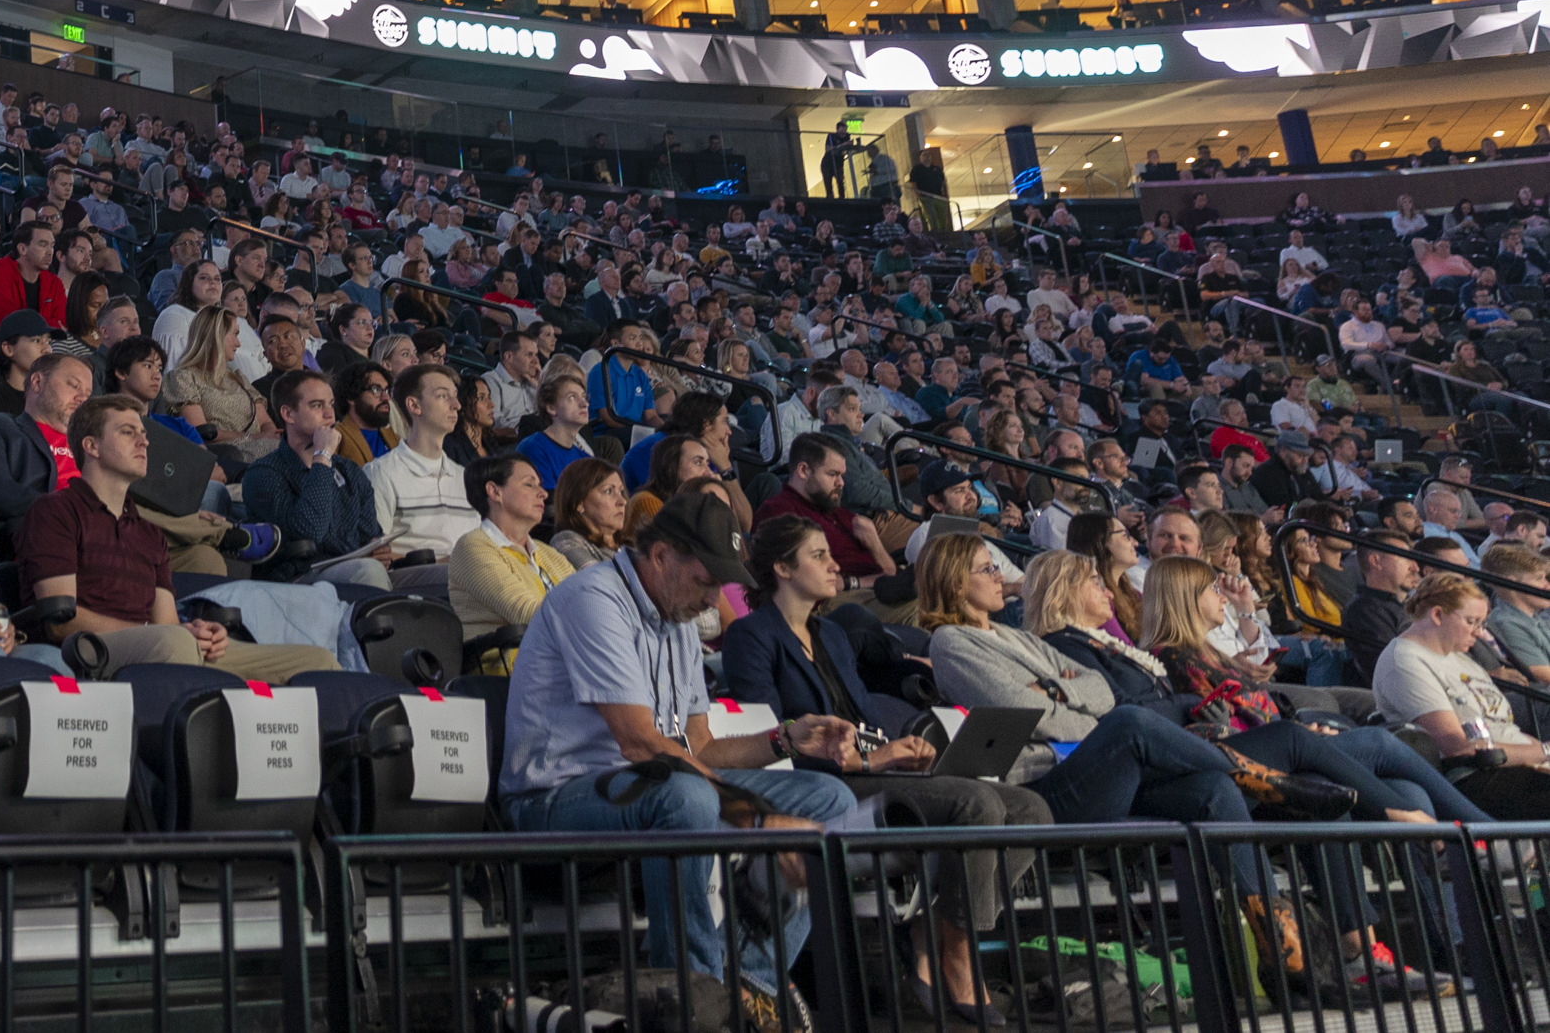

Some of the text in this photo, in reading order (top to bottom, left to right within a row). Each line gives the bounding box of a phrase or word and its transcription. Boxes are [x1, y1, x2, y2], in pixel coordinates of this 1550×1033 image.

[76, 0, 134, 23] 2 C 3
[417, 16, 557, 60] SUMMIT
[1000, 44, 1164, 77] SUMMIT
[57, 718, 108, 732] RESERVED
[256, 723, 299, 735] RESERVED
[430, 729, 470, 743] RESERVED
[72, 737, 92, 749] FOR
[271, 740, 288, 752] FOR
[443, 746, 459, 758] FOR
[66, 755, 97, 768] PRESS
[267, 757, 293, 769] PRESS
[440, 762, 464, 775] PRESS
